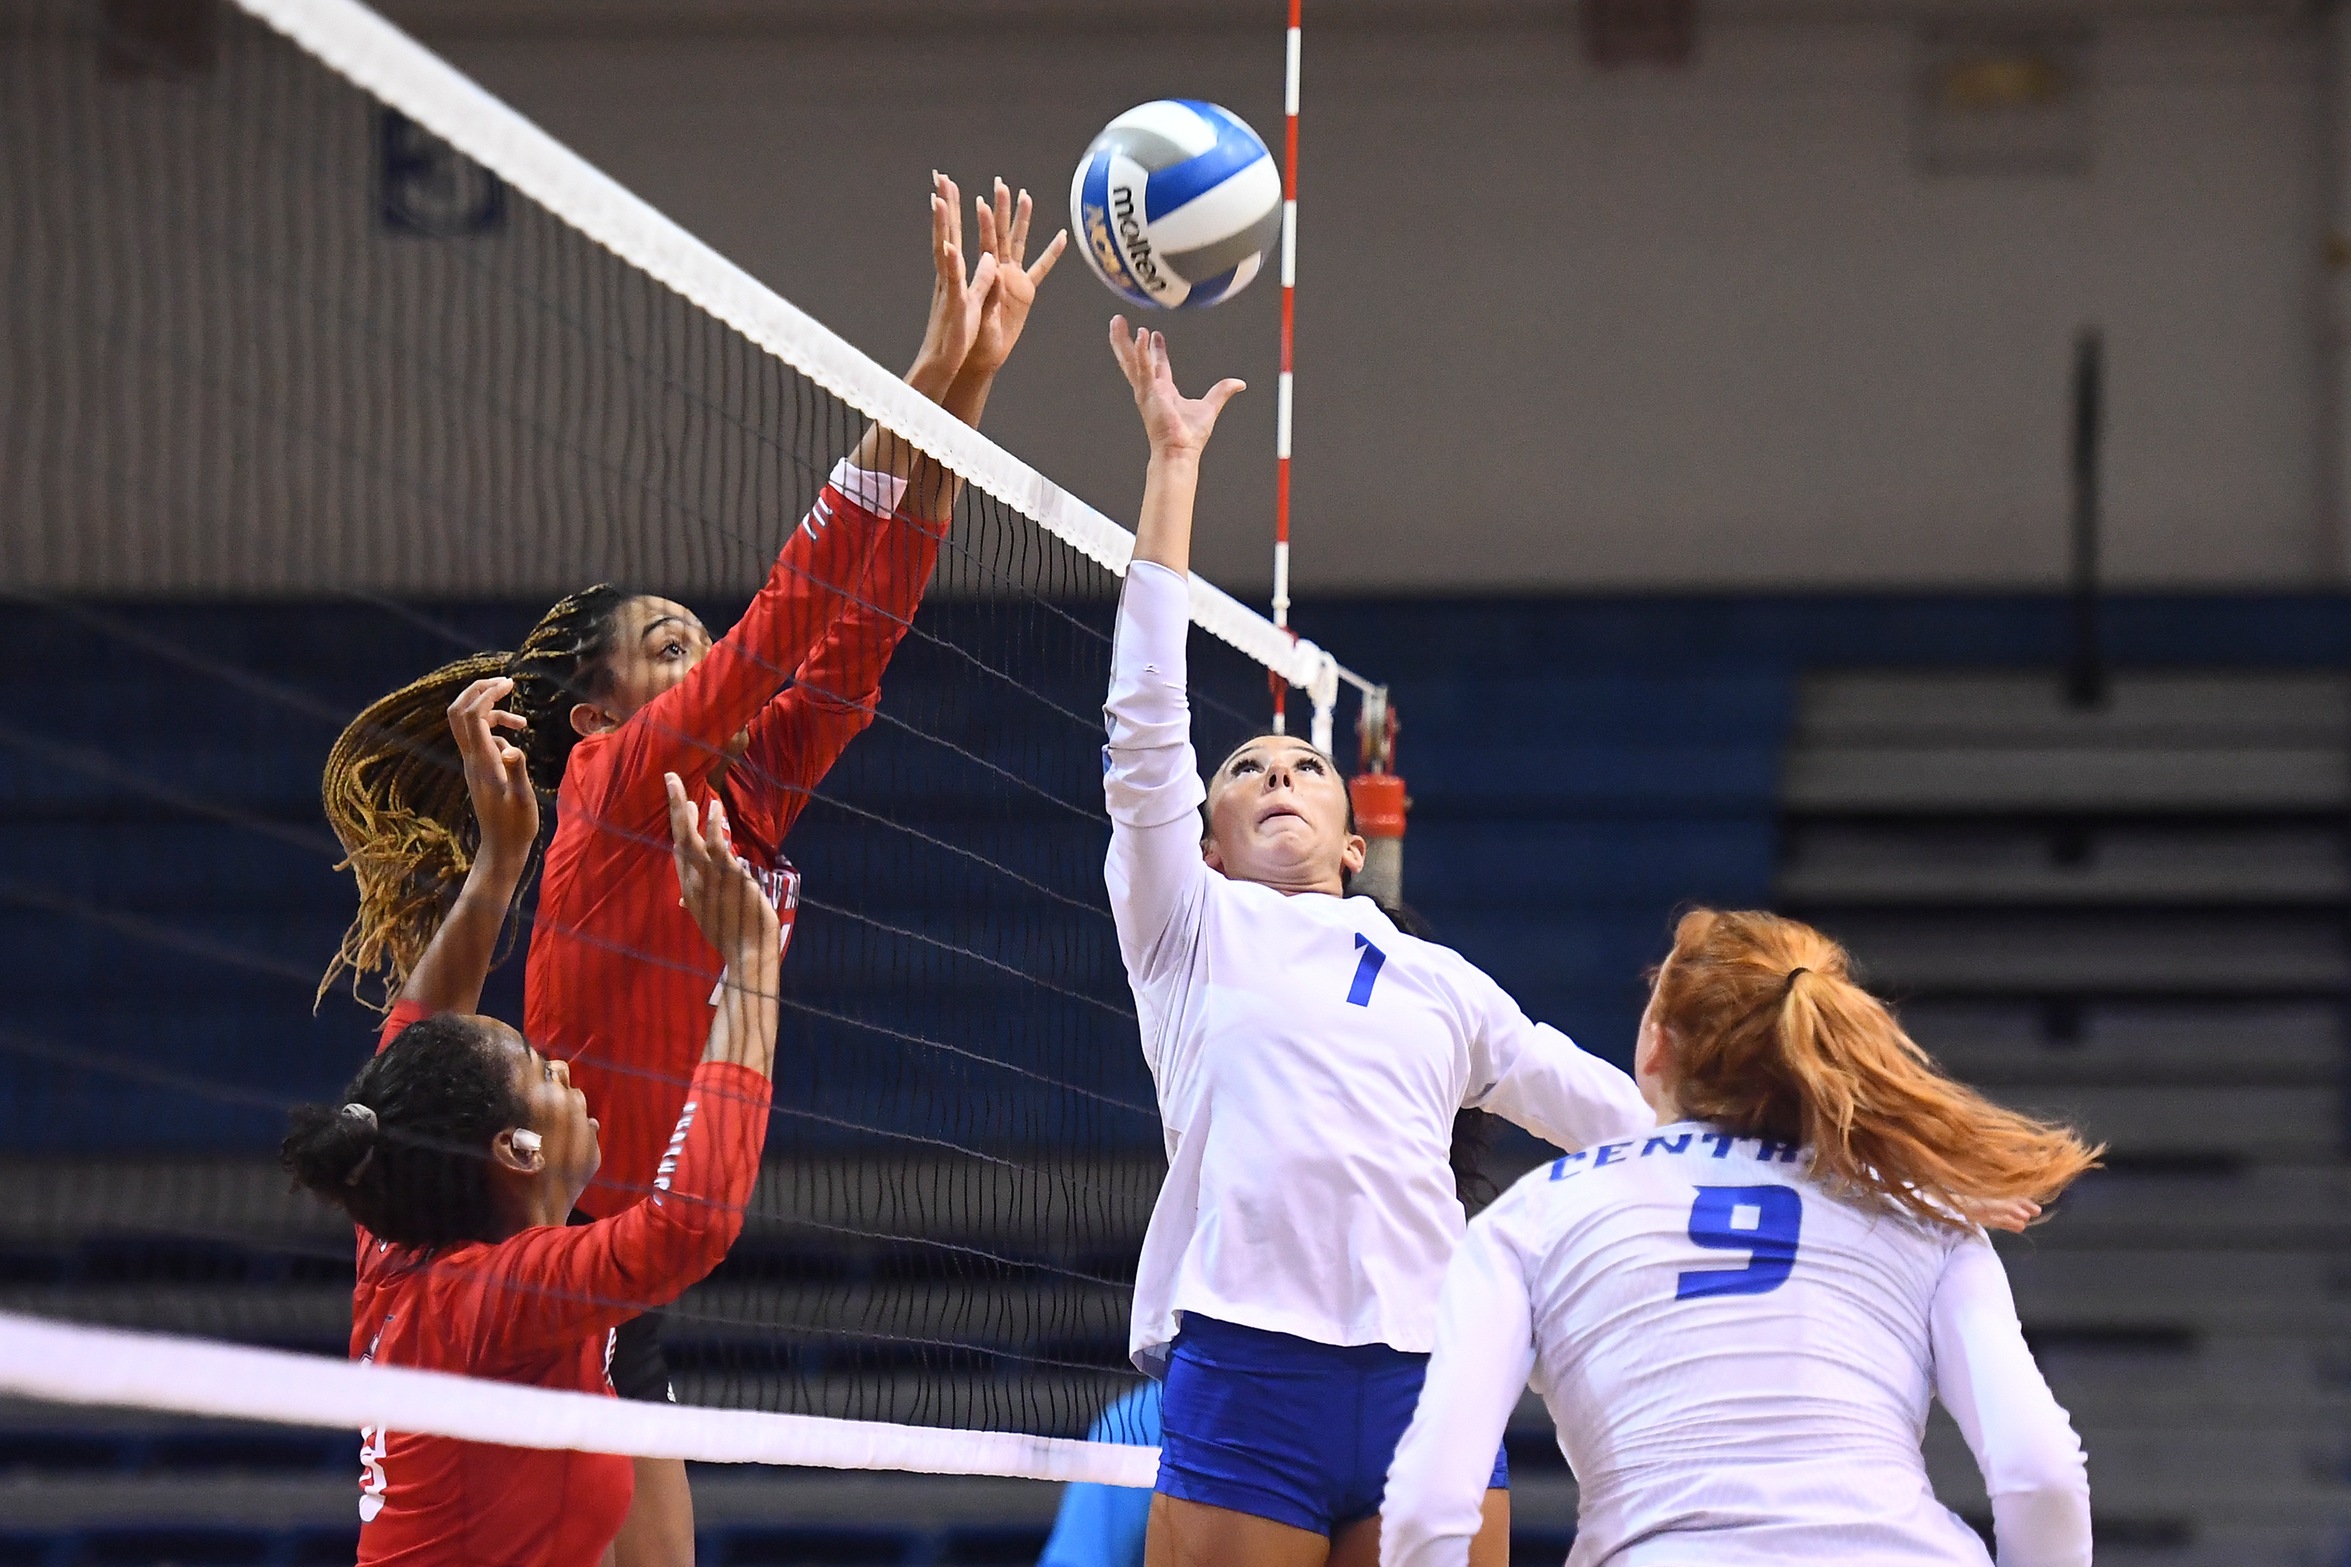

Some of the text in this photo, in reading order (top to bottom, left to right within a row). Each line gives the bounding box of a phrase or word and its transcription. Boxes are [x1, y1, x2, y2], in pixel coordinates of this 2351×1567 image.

[1112, 185, 1167, 292] molten
[1346, 932, 1387, 1007] 1
[1675, 1184, 1803, 1301] 9
